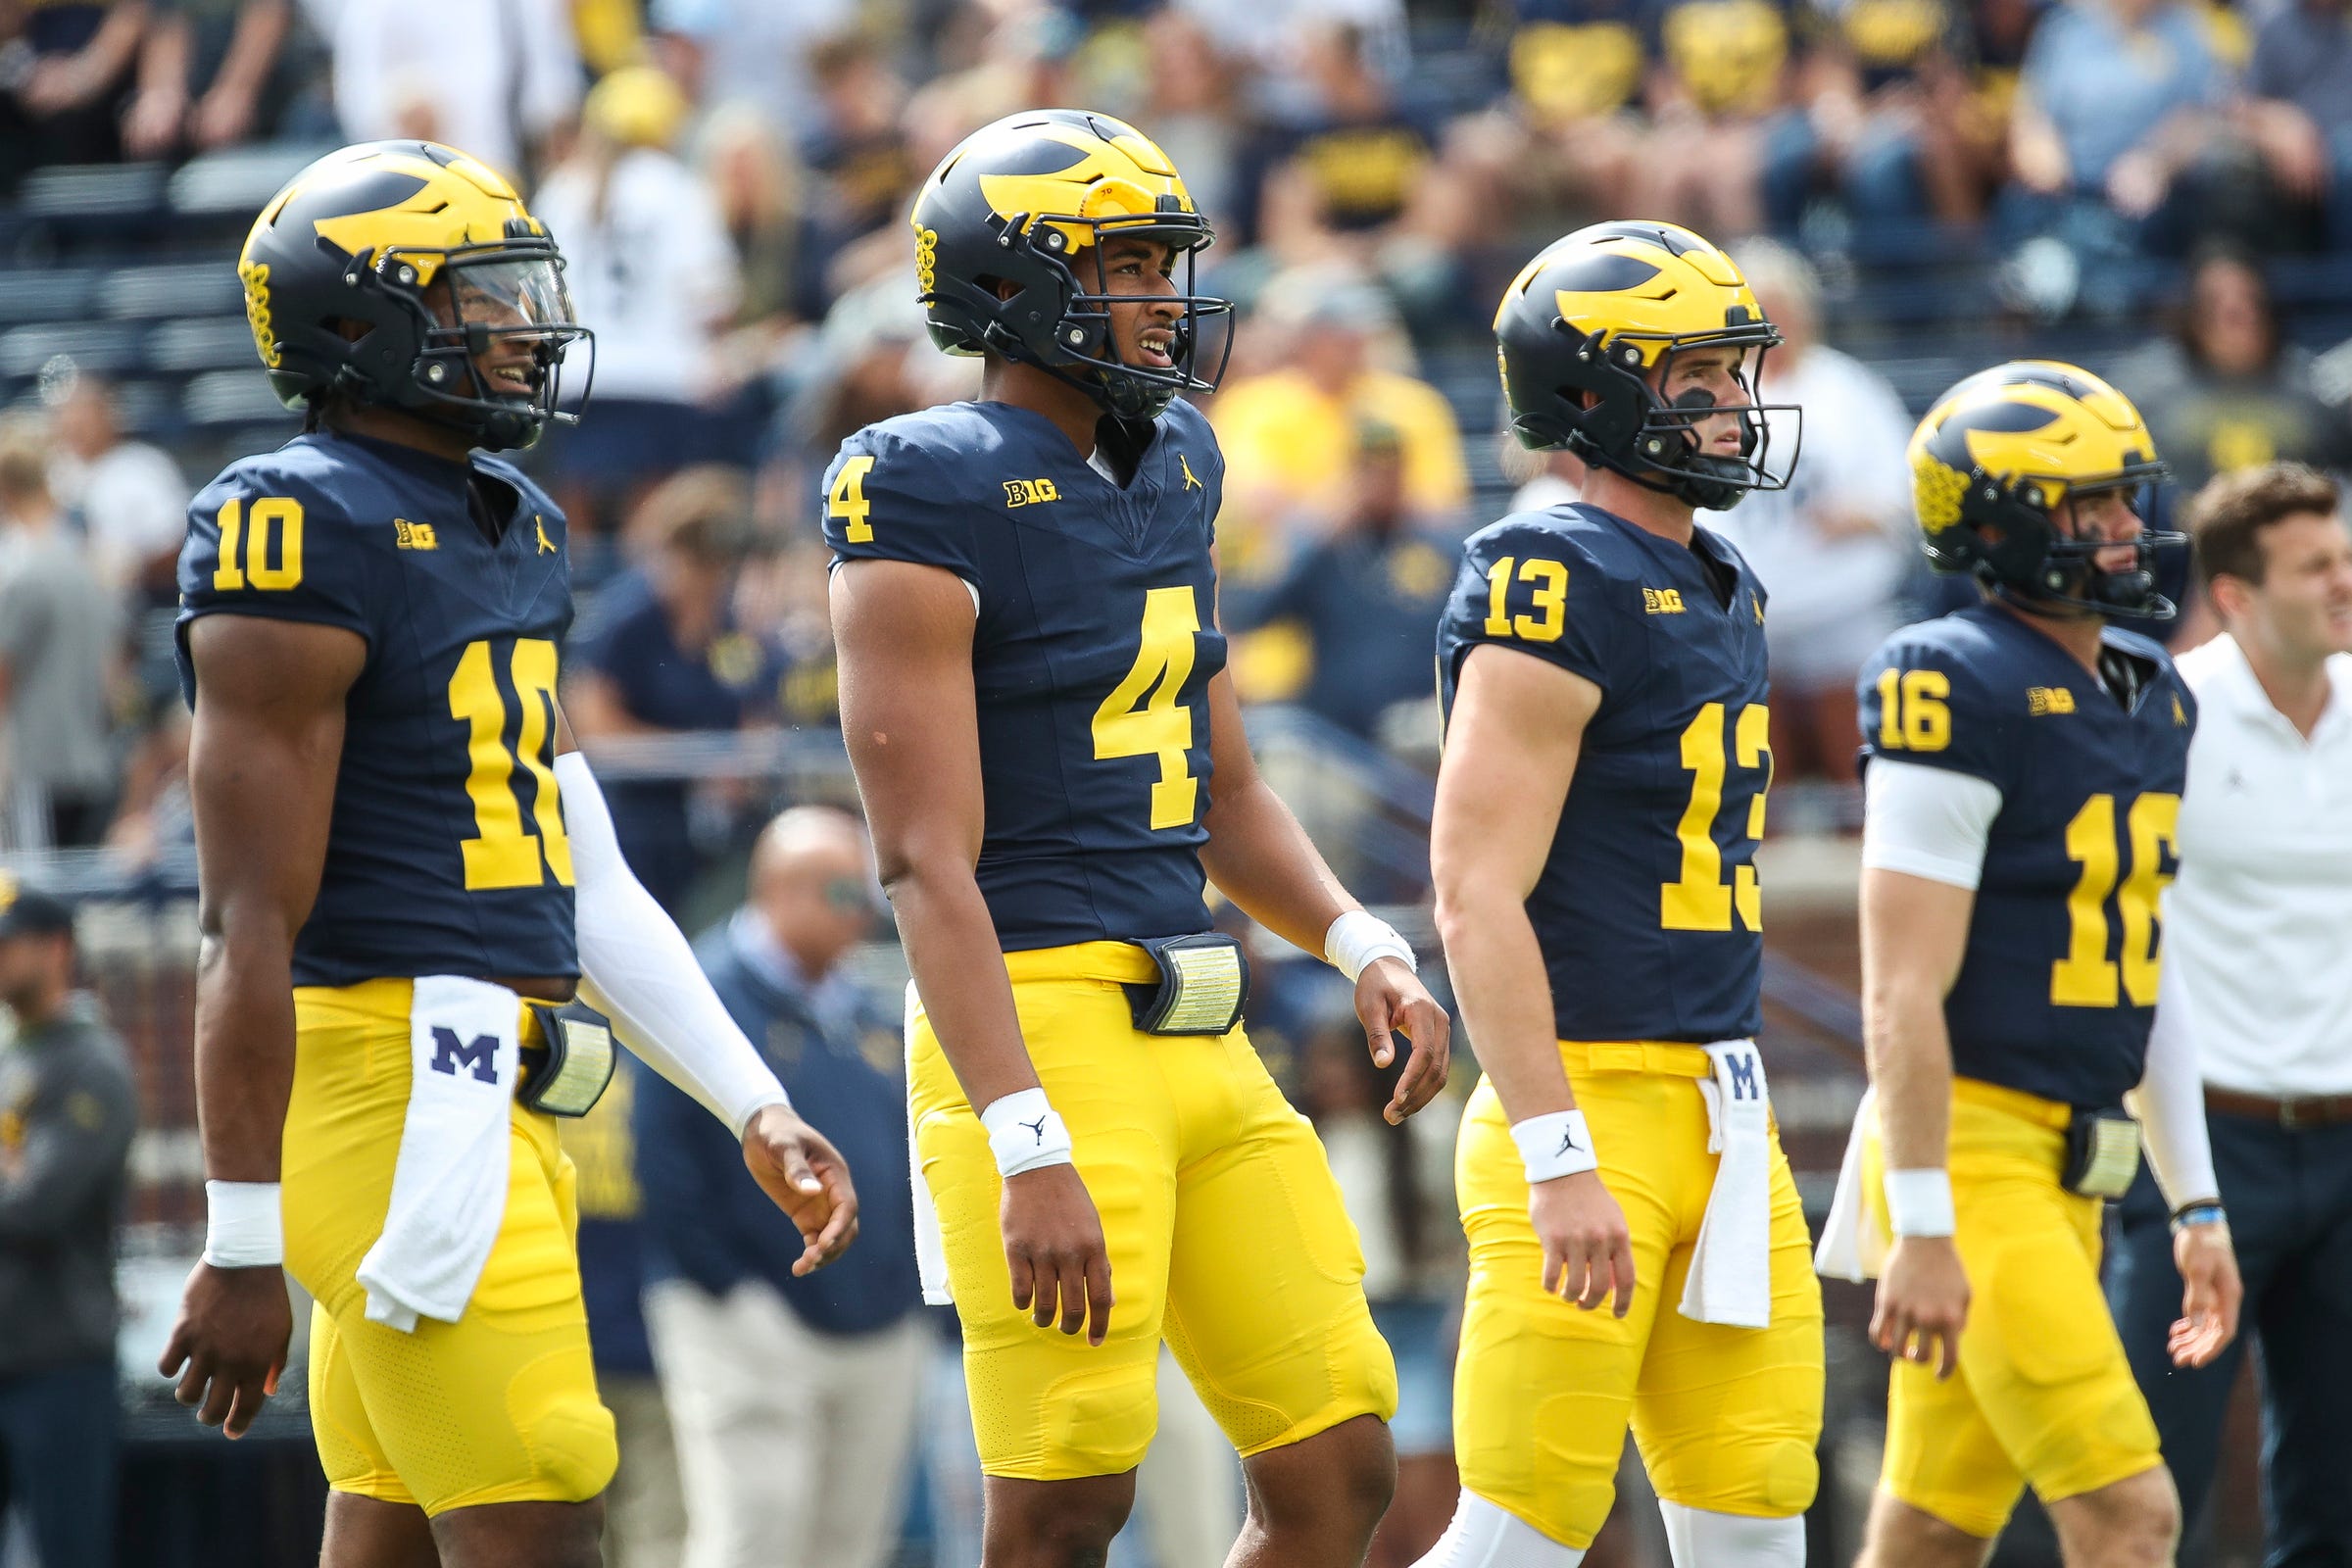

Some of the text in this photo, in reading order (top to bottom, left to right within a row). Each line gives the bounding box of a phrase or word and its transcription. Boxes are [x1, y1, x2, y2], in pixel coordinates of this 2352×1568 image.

[829, 456, 874, 543] 4
[214, 498, 304, 591] 10
[1485, 558, 1568, 643] 13
[1092, 586, 1200, 830] 4
[1879, 668, 1952, 752] 16
[431, 1026, 500, 1085] M
[1726, 1054, 1757, 1100] M
